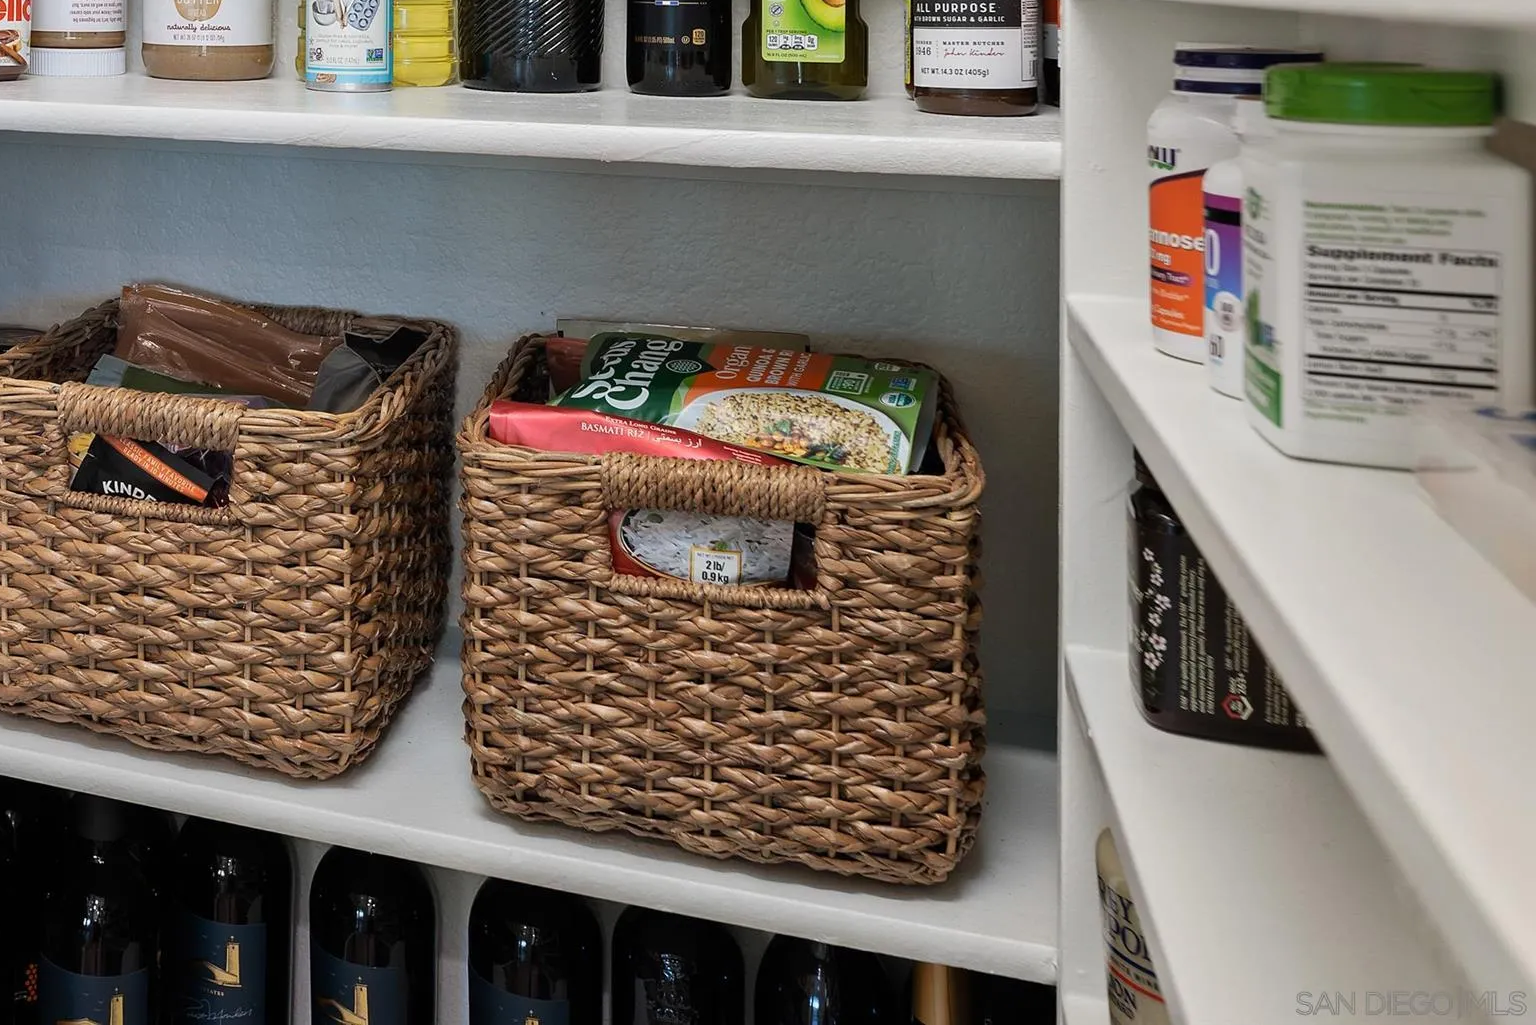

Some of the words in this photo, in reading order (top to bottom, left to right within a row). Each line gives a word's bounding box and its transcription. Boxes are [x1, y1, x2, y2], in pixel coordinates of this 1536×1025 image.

[916, 3, 930, 12] ALL
[934, 3, 996, 13] PURPOSE
[167, 24, 197, 32] naturally
[200, 23, 231, 31] delicious
[965, 68, 989, 77] (405g)
[1307, 246, 1434, 265] Supplement
[1439, 252, 1498, 268] Facts
[581, 422, 624, 436] BASMATI
[627, 427, 645, 439] RIZ
[160, 472, 185, 492] MINUTES
[165, 468, 195, 492] FAVORITE
[706, 560, 712, 570] 2
[717, 573, 729, 585] kg
